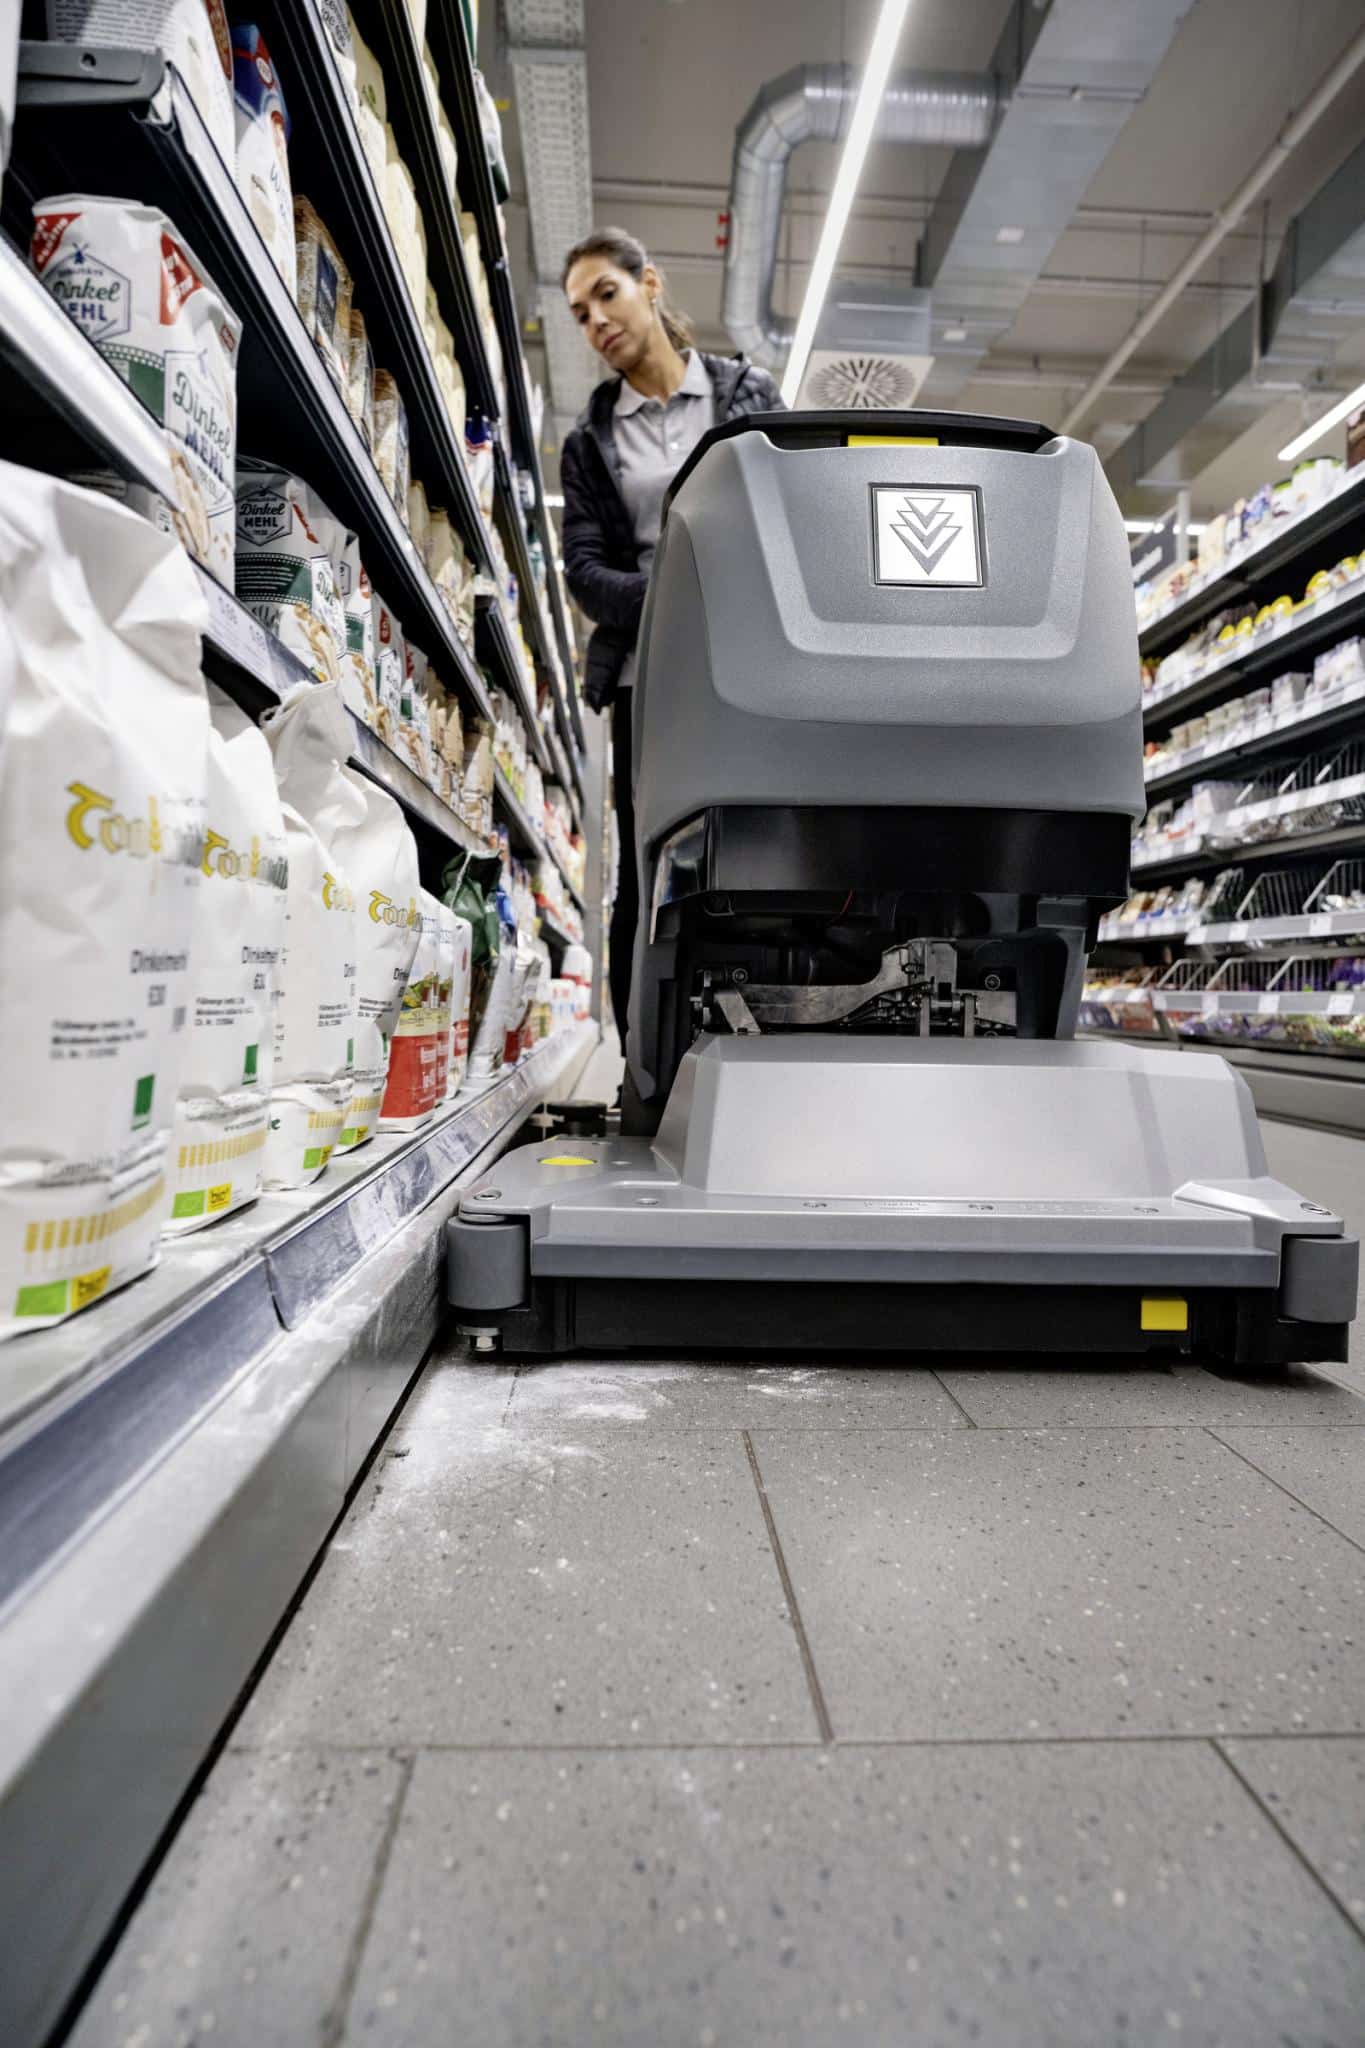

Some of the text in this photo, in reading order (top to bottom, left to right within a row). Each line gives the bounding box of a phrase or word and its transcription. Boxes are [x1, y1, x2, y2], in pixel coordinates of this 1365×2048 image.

[67, 302, 108, 321] EHL
[172, 370, 231, 459] Dinkel
[239, 503, 286, 516] Dinkel
[243, 516, 279, 528] MEHL
